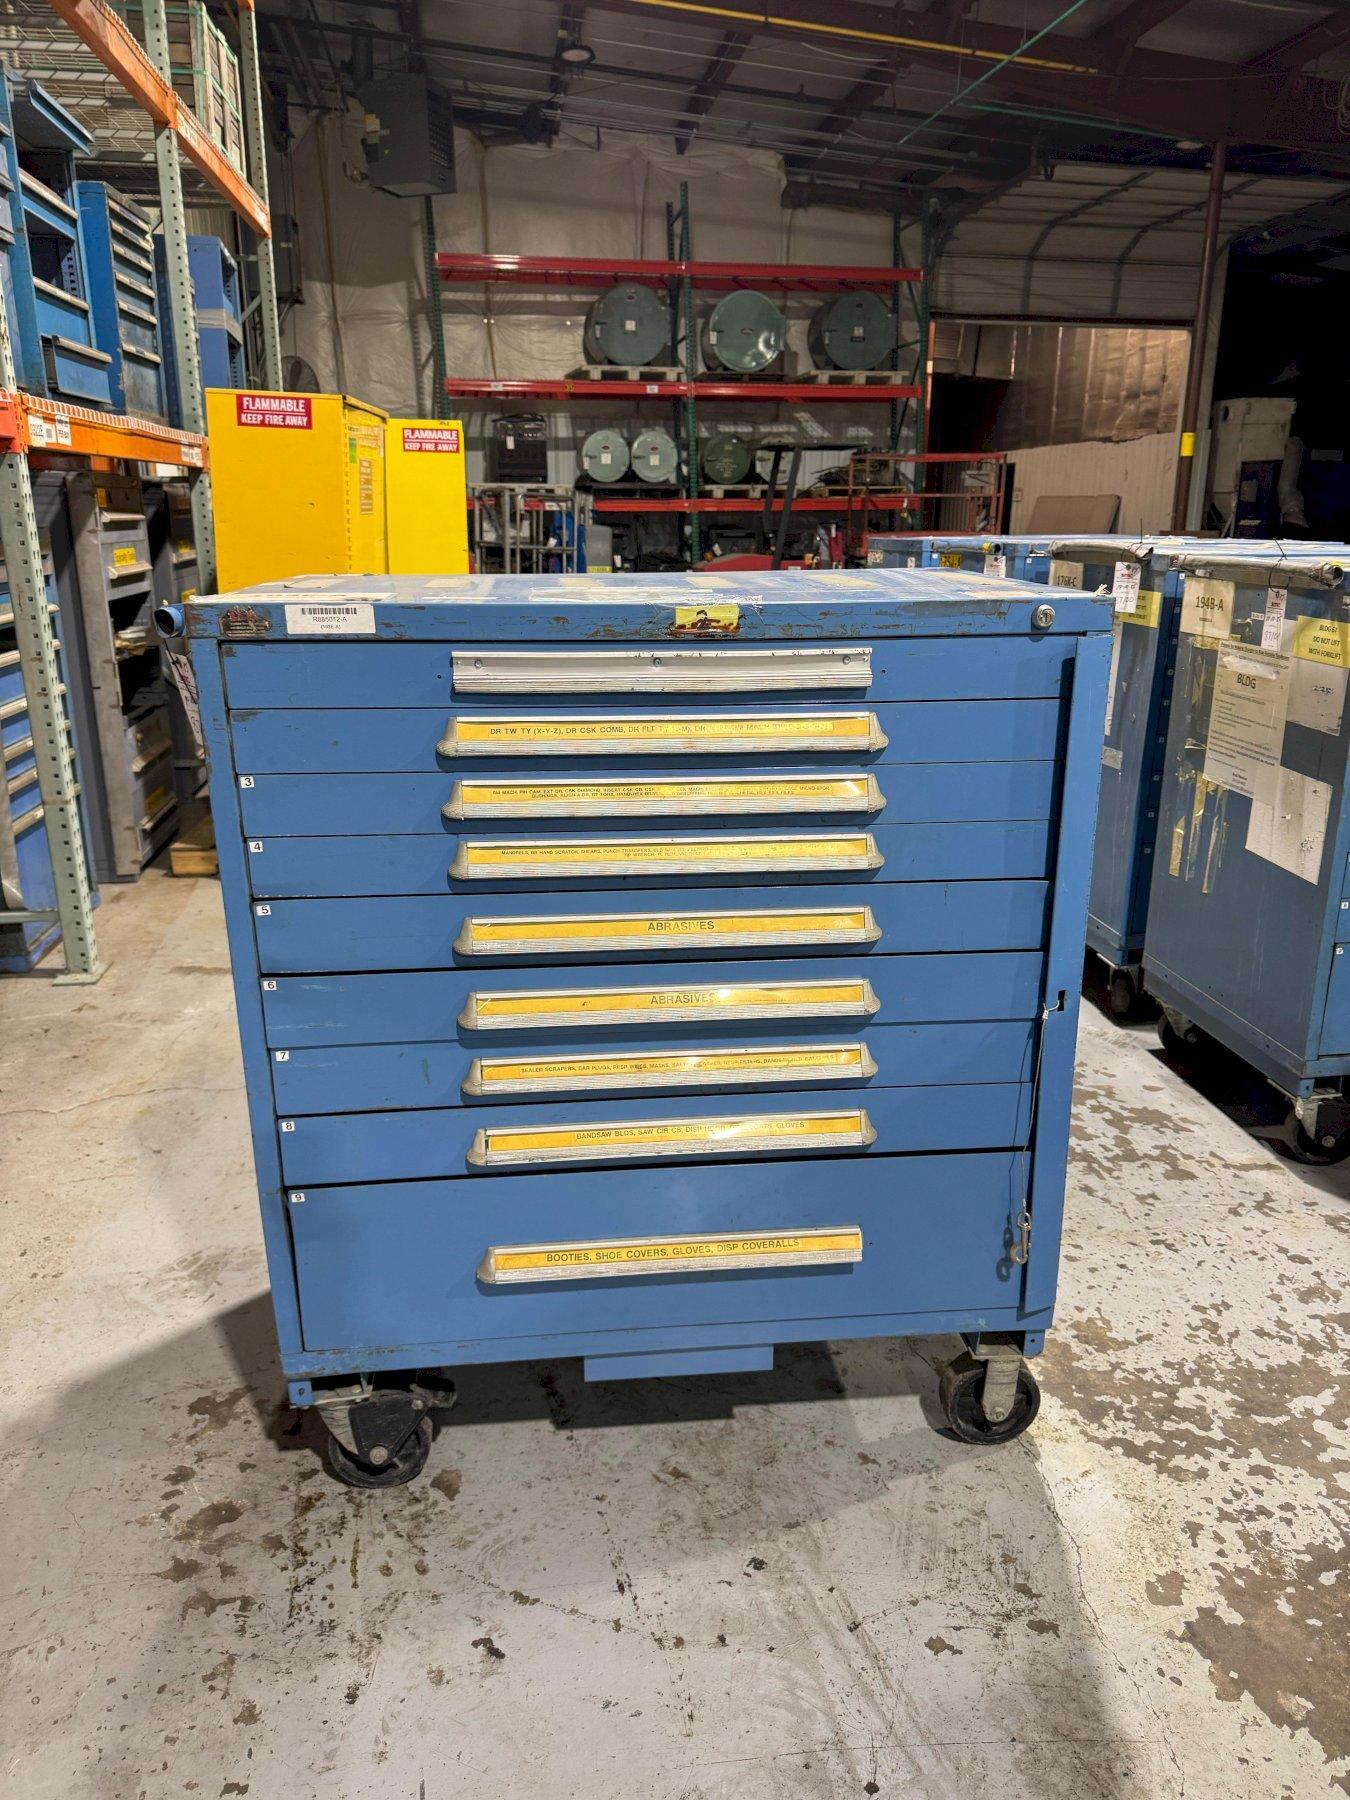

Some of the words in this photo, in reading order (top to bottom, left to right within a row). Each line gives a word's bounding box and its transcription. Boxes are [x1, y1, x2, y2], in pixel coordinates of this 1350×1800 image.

[242, 396, 306, 412] FLAMMABLE
[240, 412, 263, 424] KEEP
[264, 414, 284, 426] FIRE
[284, 415, 308, 426] AWAY
[404, 428, 458, 440] FLAMMABLE
[404, 442, 421, 451] KEEP
[422, 442, 436, 452] FIRE
[436, 443, 458, 452] AWAY
[1195, 596, 1224, 612] 194B-A
[1320, 637, 1331, 645] NOT
[1308, 648, 1321, 656] WITH
[1320, 650, 1342, 660] FORKLIFT
[1236, 673, 1256, 690] BLDG
[533, 726, 564, 736] (X-Y-Z),
[566, 726, 577, 734] DR
[579, 726, 597, 734] CSK
[600, 726, 626, 734] COMB,
[244, 777, 252, 786] 3
[253, 842, 261, 851] 4
[261, 906, 269, 914] 5
[648, 920, 715, 932] ABRASIVES
[267, 981, 275, 990] 6
[650, 992, 716, 1005] ABRASIVES
[279, 1051, 287, 1060] 7
[285, 1122, 293, 1131] 8
[576, 1131, 612, 1140] BANDSAW
[638, 1128, 654, 1136] SAW
[294, 1193, 302, 1202] 9
[546, 1252, 592, 1262] BOOTIES,
[595, 1250, 623, 1260] SHOE
[626, 1248, 669, 1259] COVERS,
[672, 1245, 714, 1256] GLOVES,
[717, 1243, 739, 1252] DISP
[741, 1238, 800, 1251] COVERALLS
